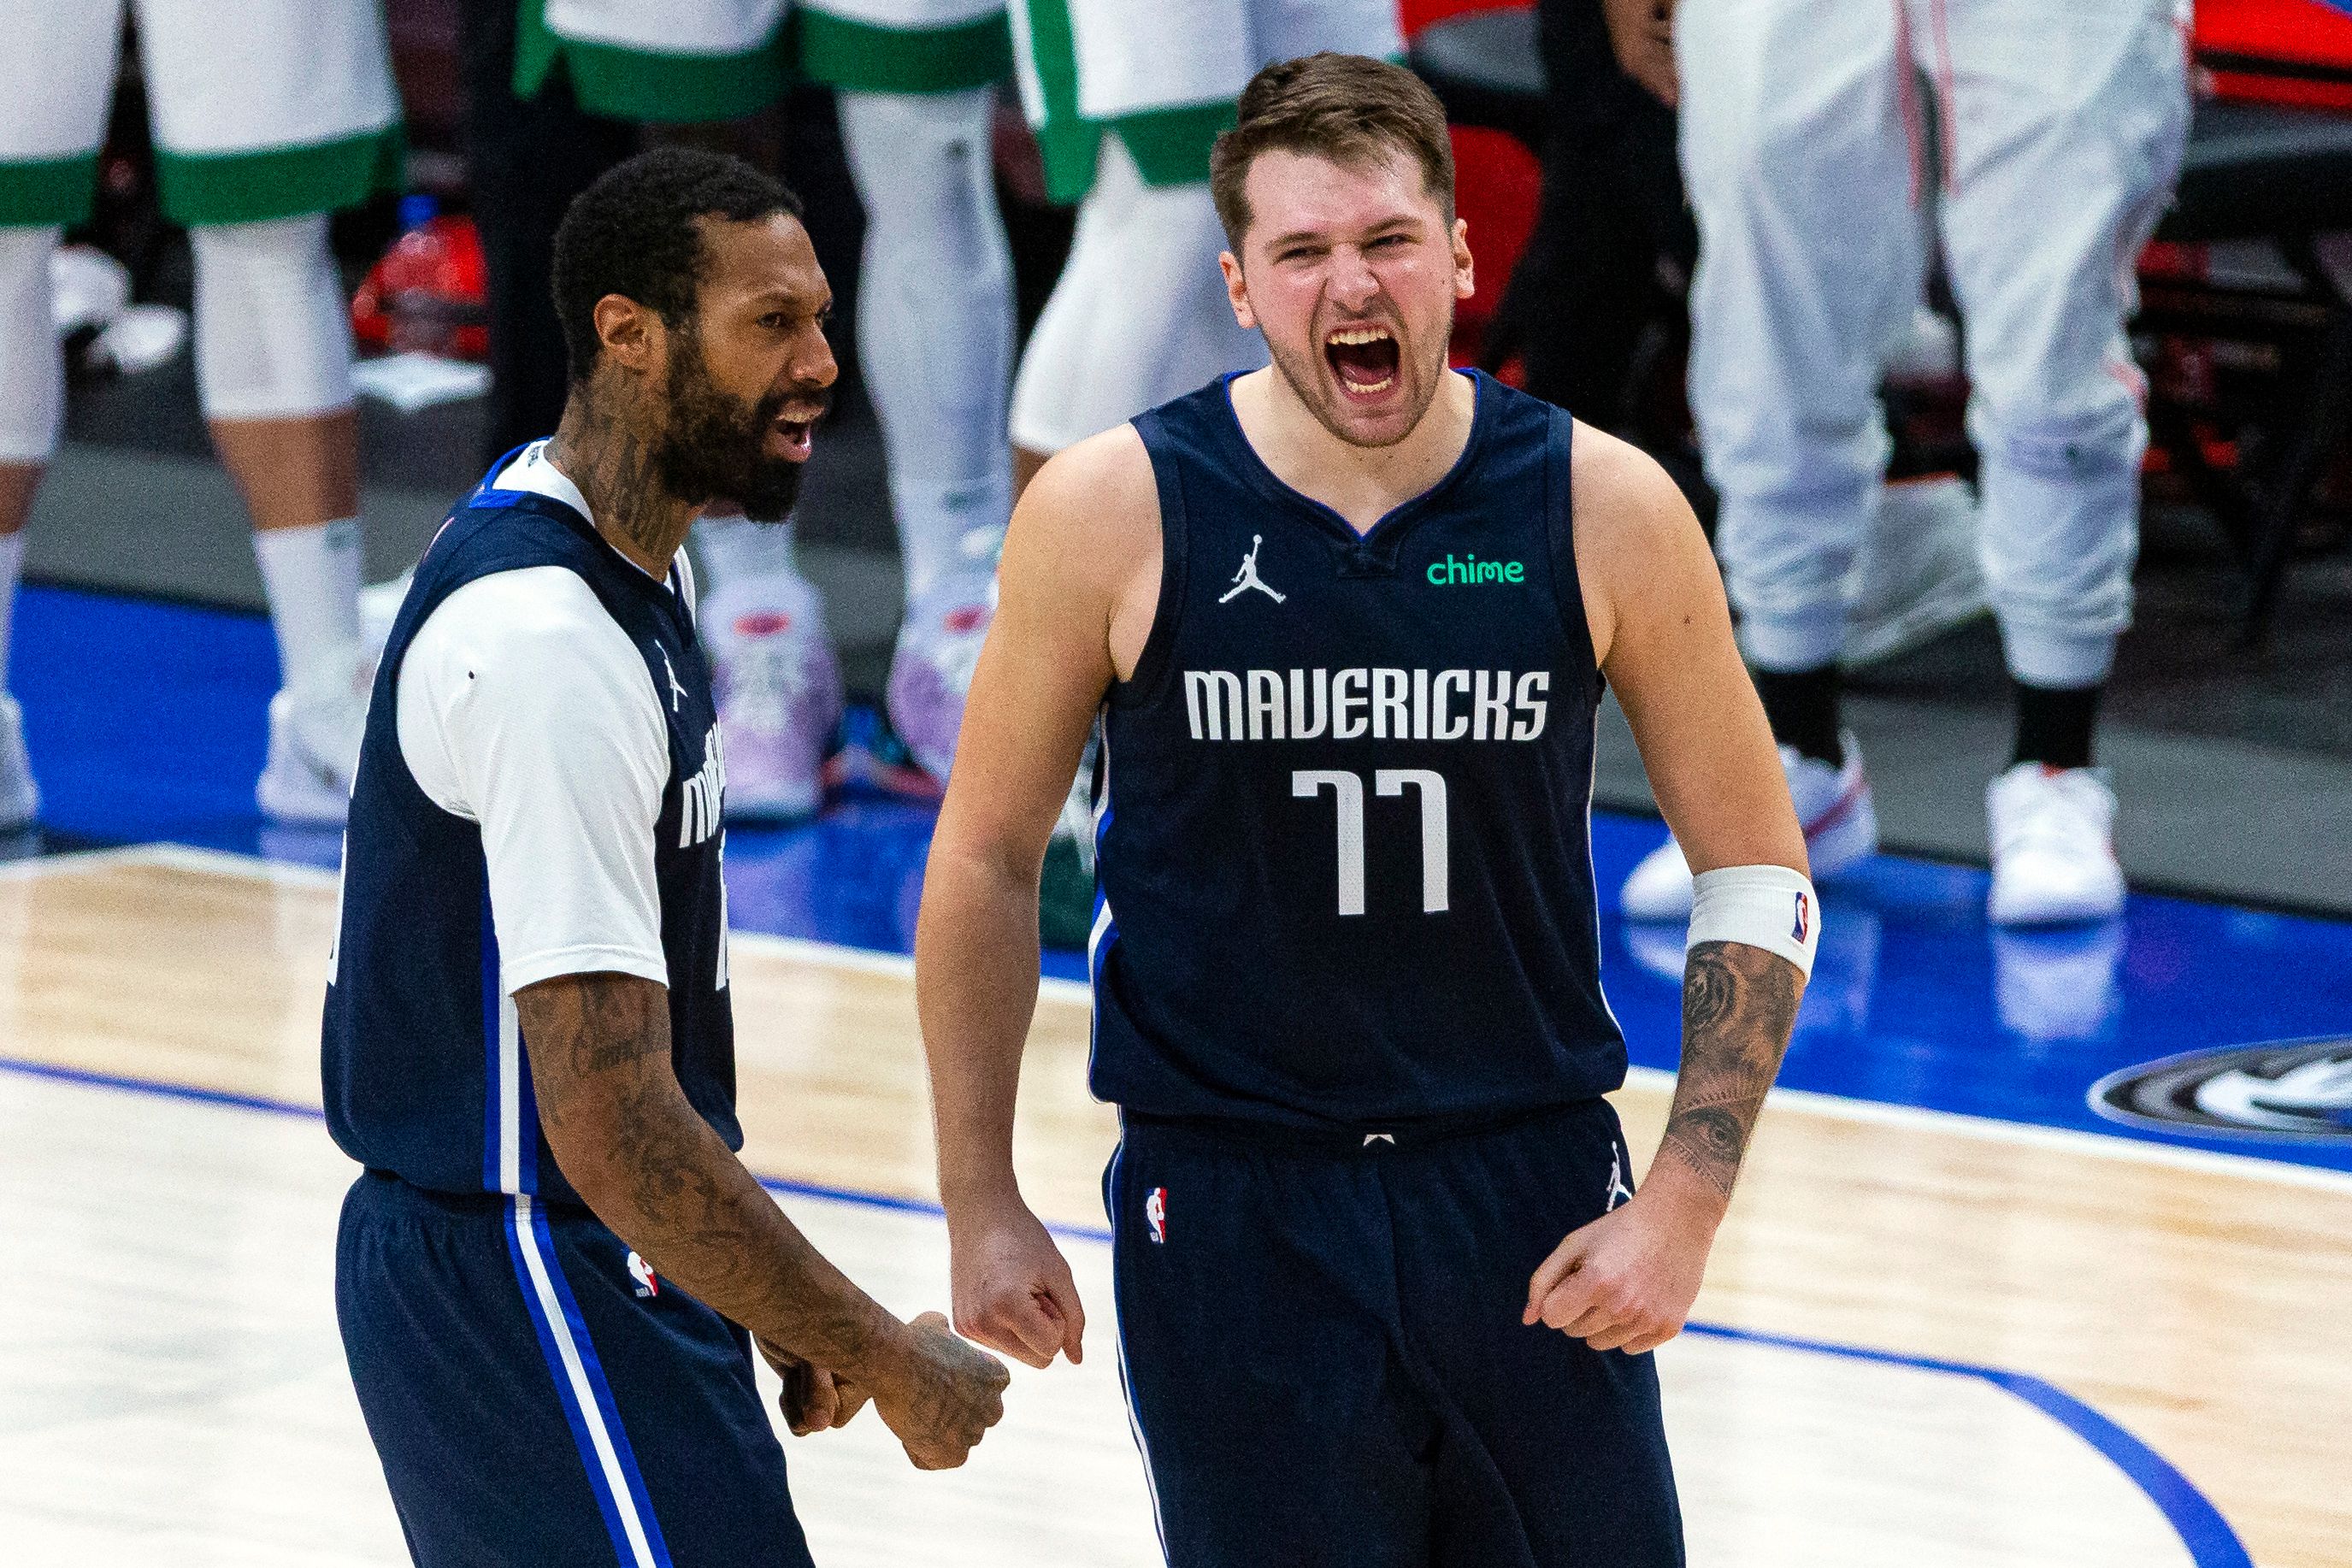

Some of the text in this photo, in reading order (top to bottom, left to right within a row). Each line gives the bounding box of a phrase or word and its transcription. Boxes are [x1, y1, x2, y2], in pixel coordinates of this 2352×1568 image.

[1427, 554, 1524, 585] chime
[1184, 668, 1550, 741] MAVERICKS
[1292, 769, 1449, 916] 77
